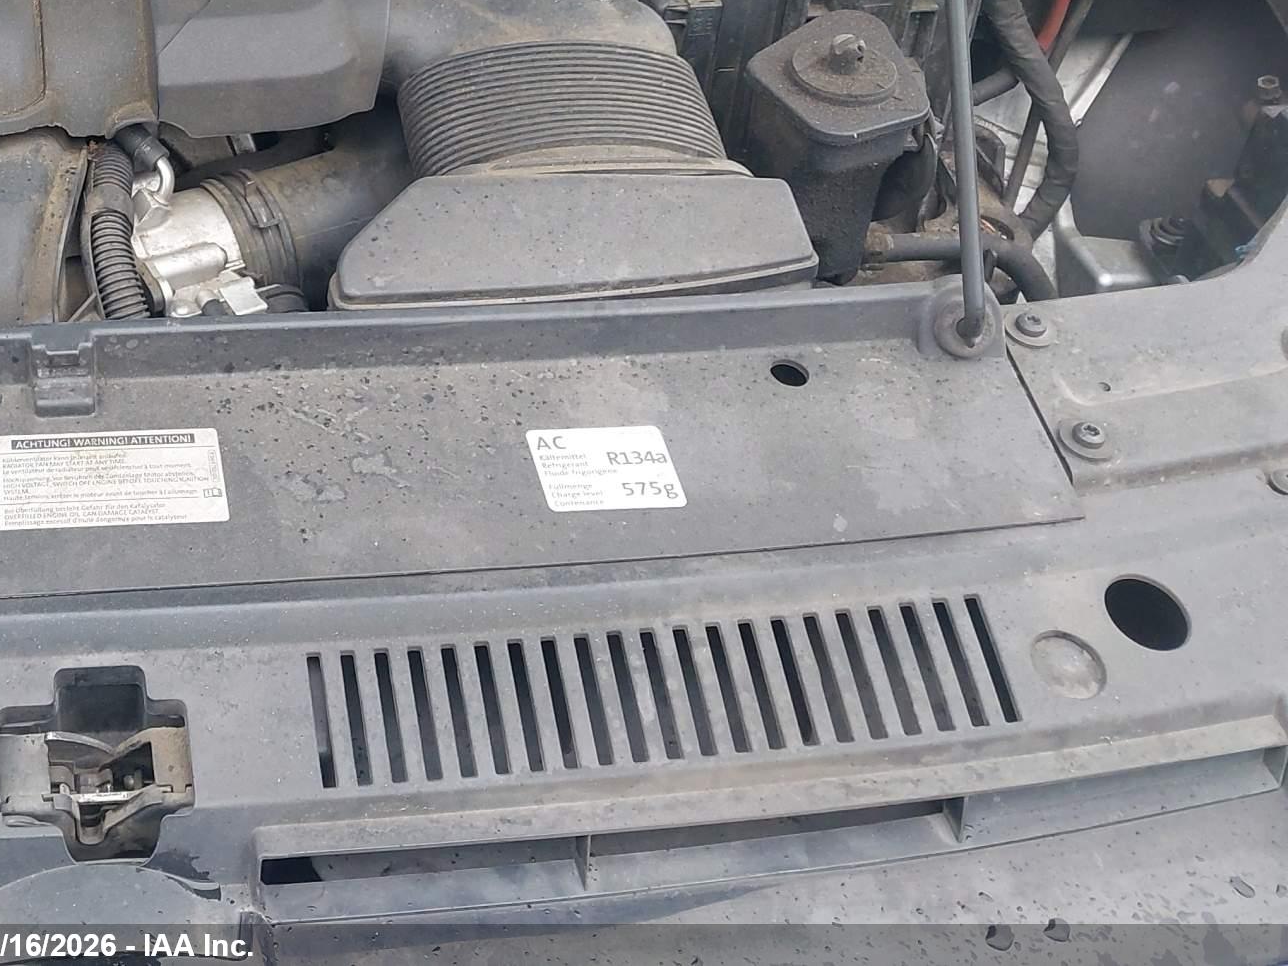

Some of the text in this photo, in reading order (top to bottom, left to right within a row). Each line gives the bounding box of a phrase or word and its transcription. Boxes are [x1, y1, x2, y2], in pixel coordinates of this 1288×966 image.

[15, 434, 191, 450] ACHTUNG! WARNING! ATTENTION!
[606, 450, 668, 465] R134a
[541, 461, 589, 470] Refrigerant
[551, 491, 581, 500] Charge
[621, 481, 679, 500] 575g
